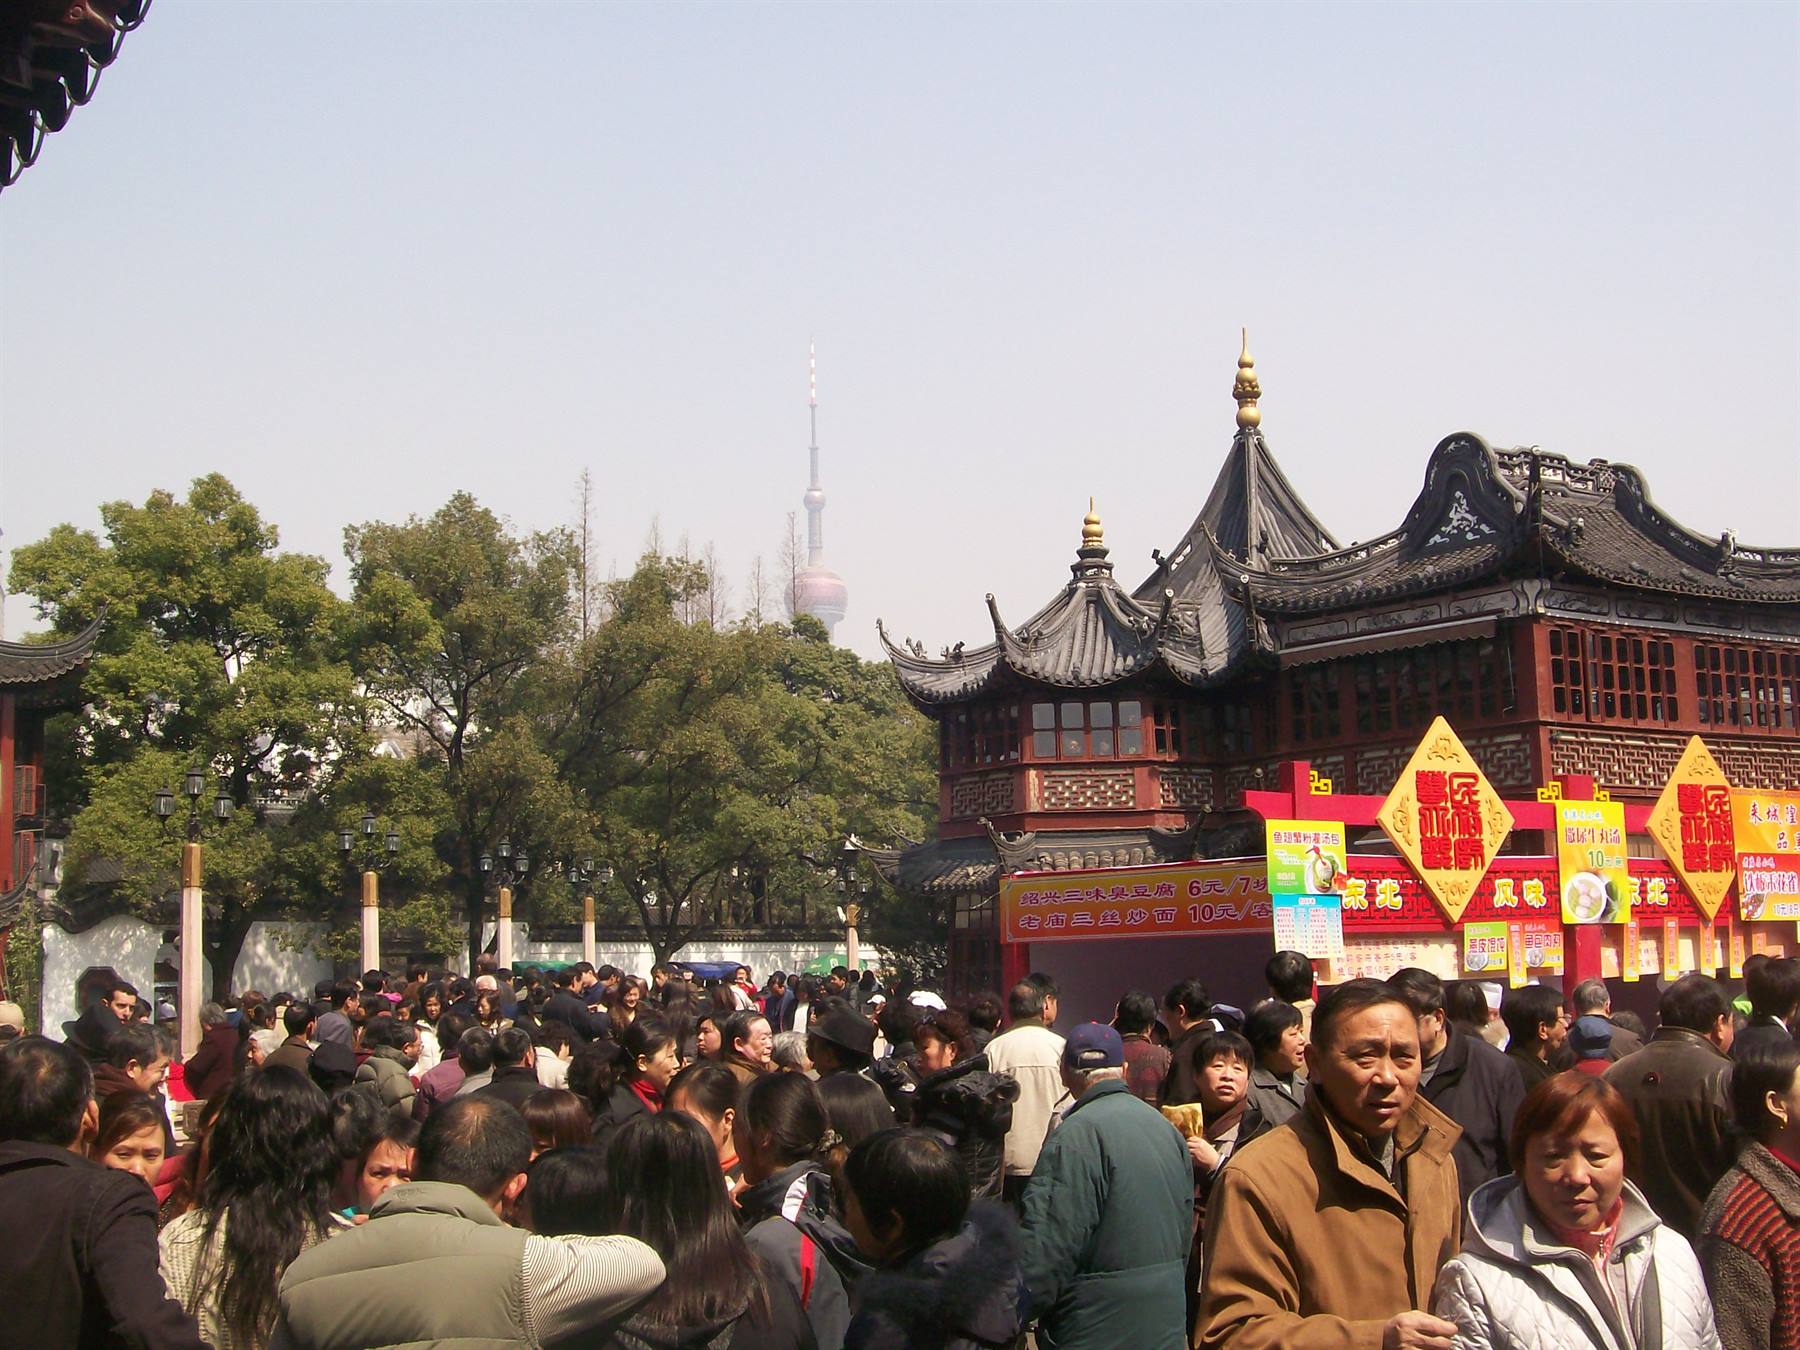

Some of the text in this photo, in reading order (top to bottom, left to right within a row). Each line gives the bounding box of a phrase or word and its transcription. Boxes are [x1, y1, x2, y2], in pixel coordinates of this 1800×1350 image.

[1020, 883, 1177, 906] 绍兴三味臭豆腐
[1342, 878, 1546, 910] 东北 风味
[1019, 906, 1177, 929] 老庙三丝炒面
